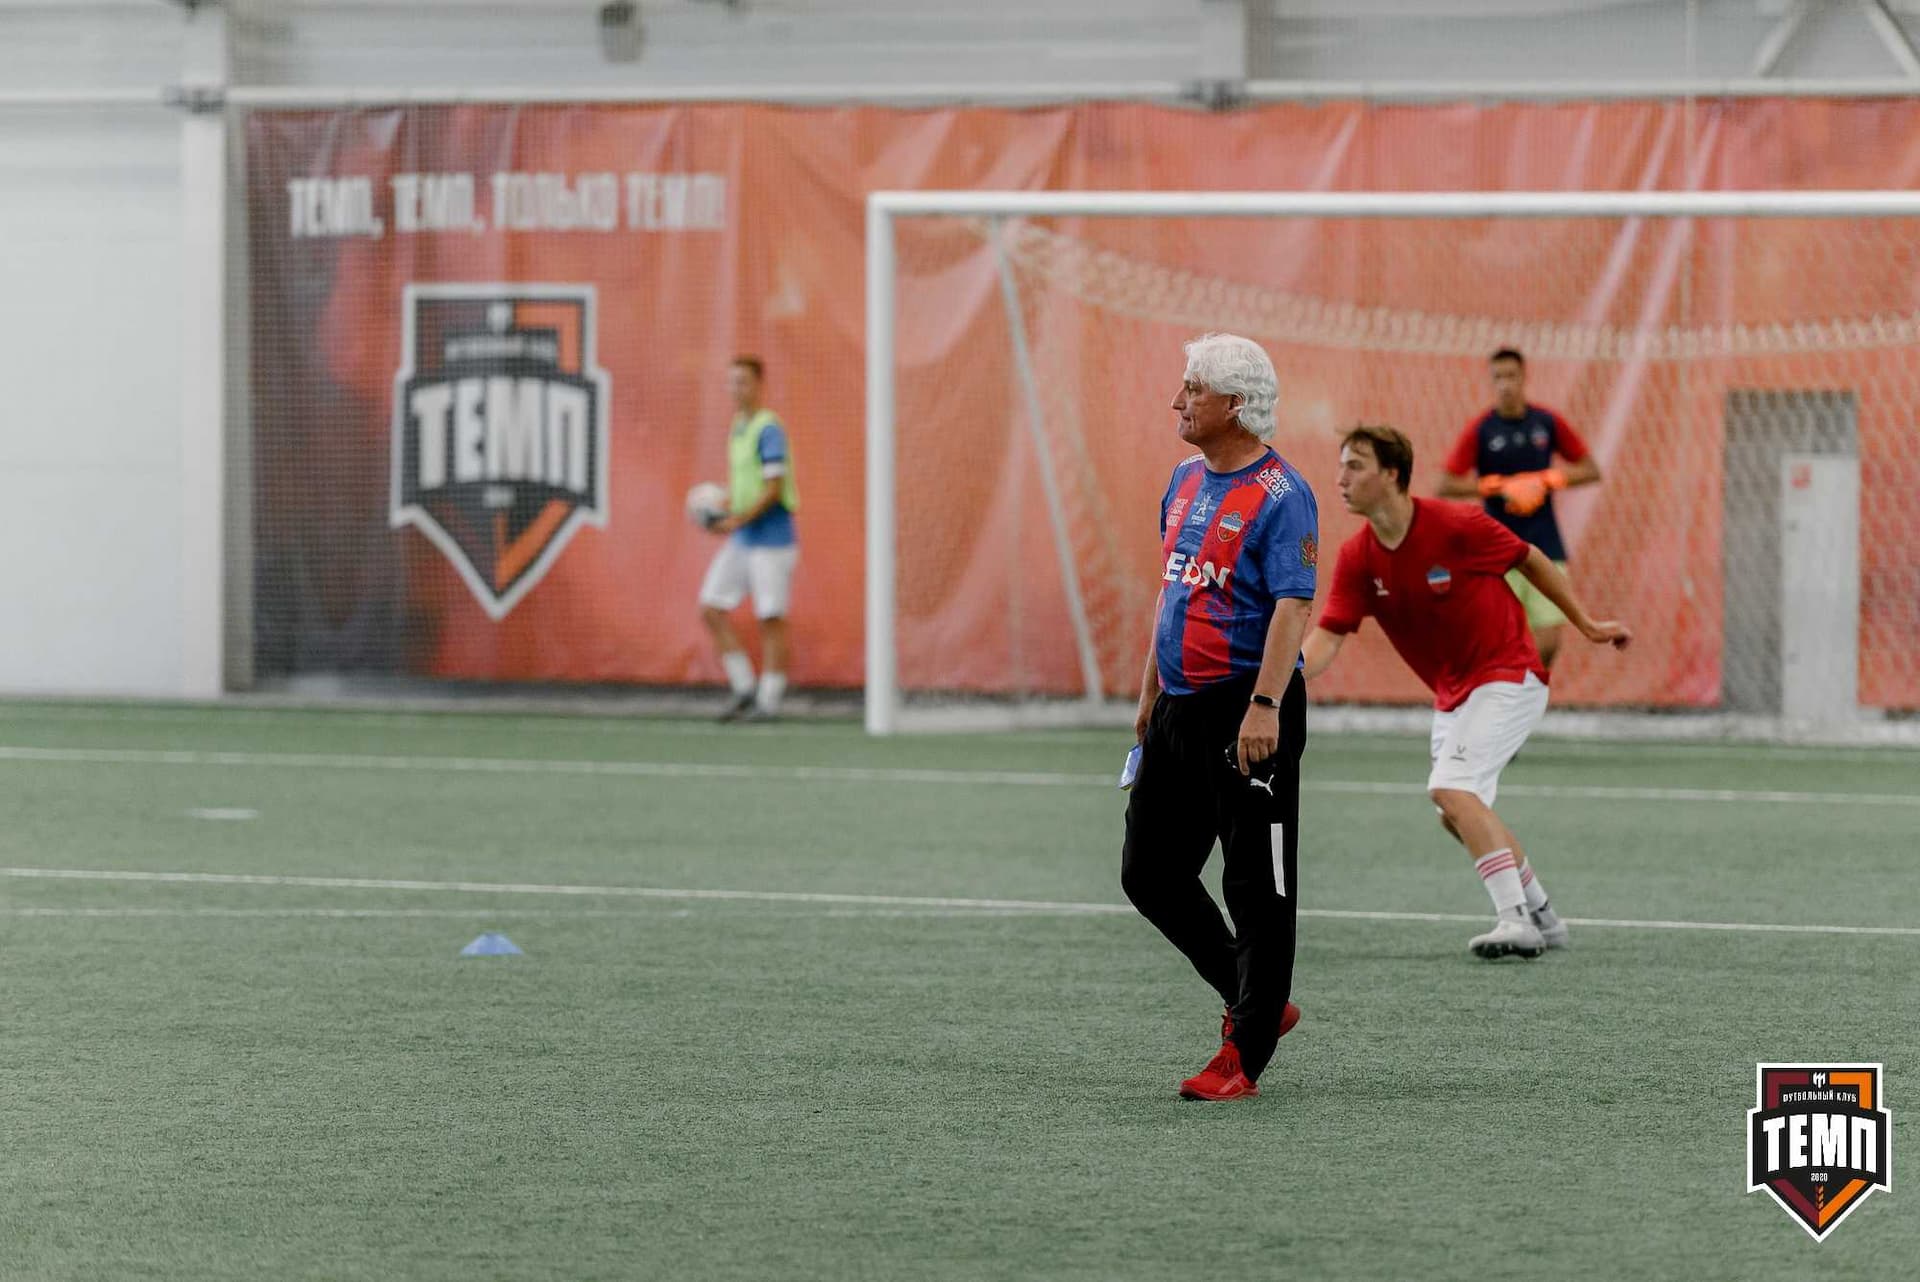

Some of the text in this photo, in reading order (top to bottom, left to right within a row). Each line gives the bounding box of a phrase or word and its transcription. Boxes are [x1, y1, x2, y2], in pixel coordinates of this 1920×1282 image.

[288, 177, 384, 239] ТЕМП,
[410, 377, 589, 495] ТЕМП
[1270, 468, 1293, 492] doctor
[1162, 551, 1231, 590] EON
